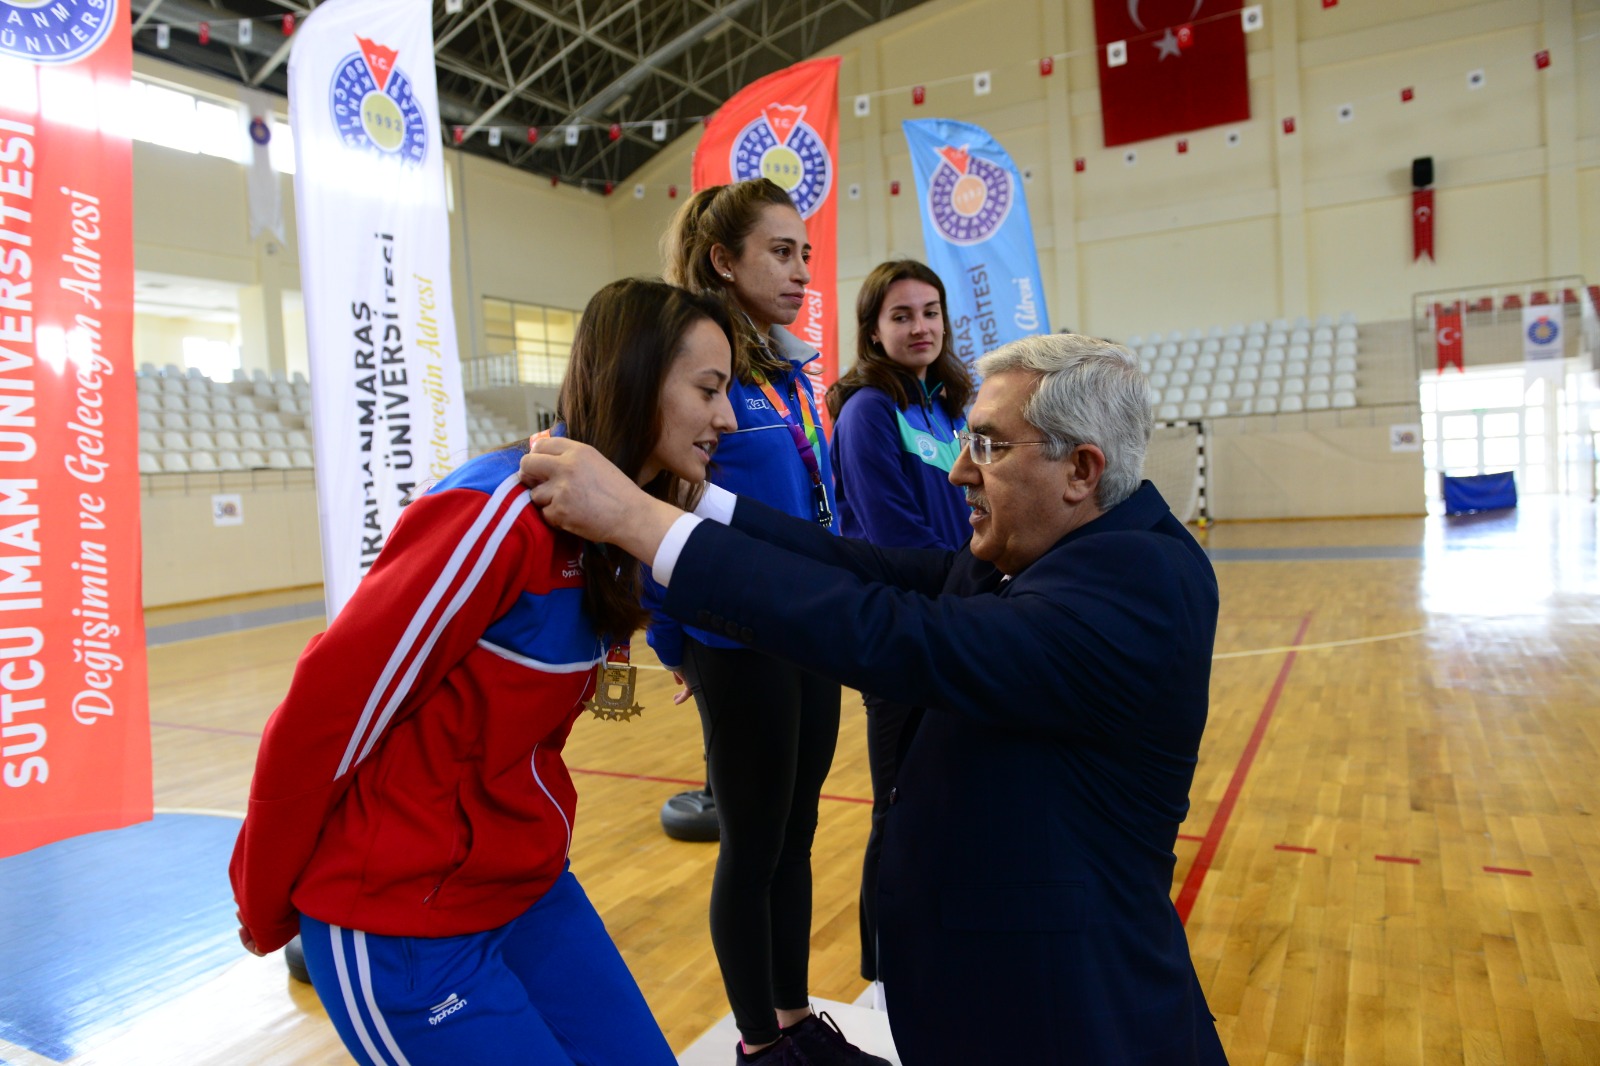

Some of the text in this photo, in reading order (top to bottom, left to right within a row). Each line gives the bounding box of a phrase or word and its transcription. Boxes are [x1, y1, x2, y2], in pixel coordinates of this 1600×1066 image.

[60, 186, 101, 310] Adresi
[412, 273, 442, 359] Adresi
[79, 493, 106, 530] ve
[71, 540, 124, 725] Değişimin
[428, 999, 467, 1026] typhoon
